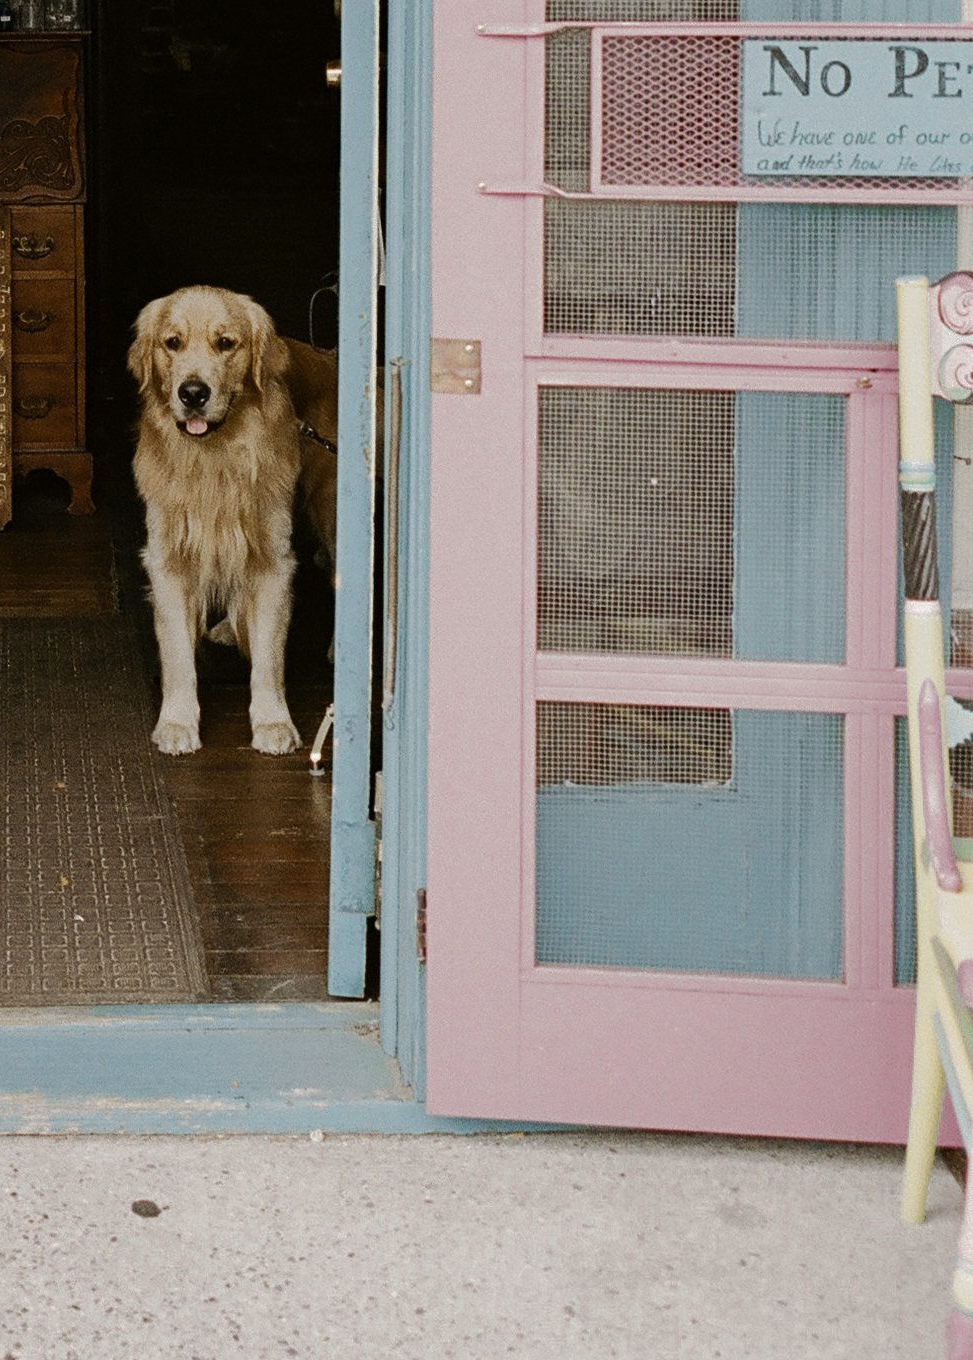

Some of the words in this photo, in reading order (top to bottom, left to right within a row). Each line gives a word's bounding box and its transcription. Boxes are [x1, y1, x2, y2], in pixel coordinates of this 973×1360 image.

[888, 45, 973, 98] PE
[758, 118, 785, 147] We
[789, 121, 835, 146] have
[886, 124, 910, 145] of
[916, 132, 952, 146] our
[798, 151, 844, 170] that's
[849, 153, 883, 171] how
